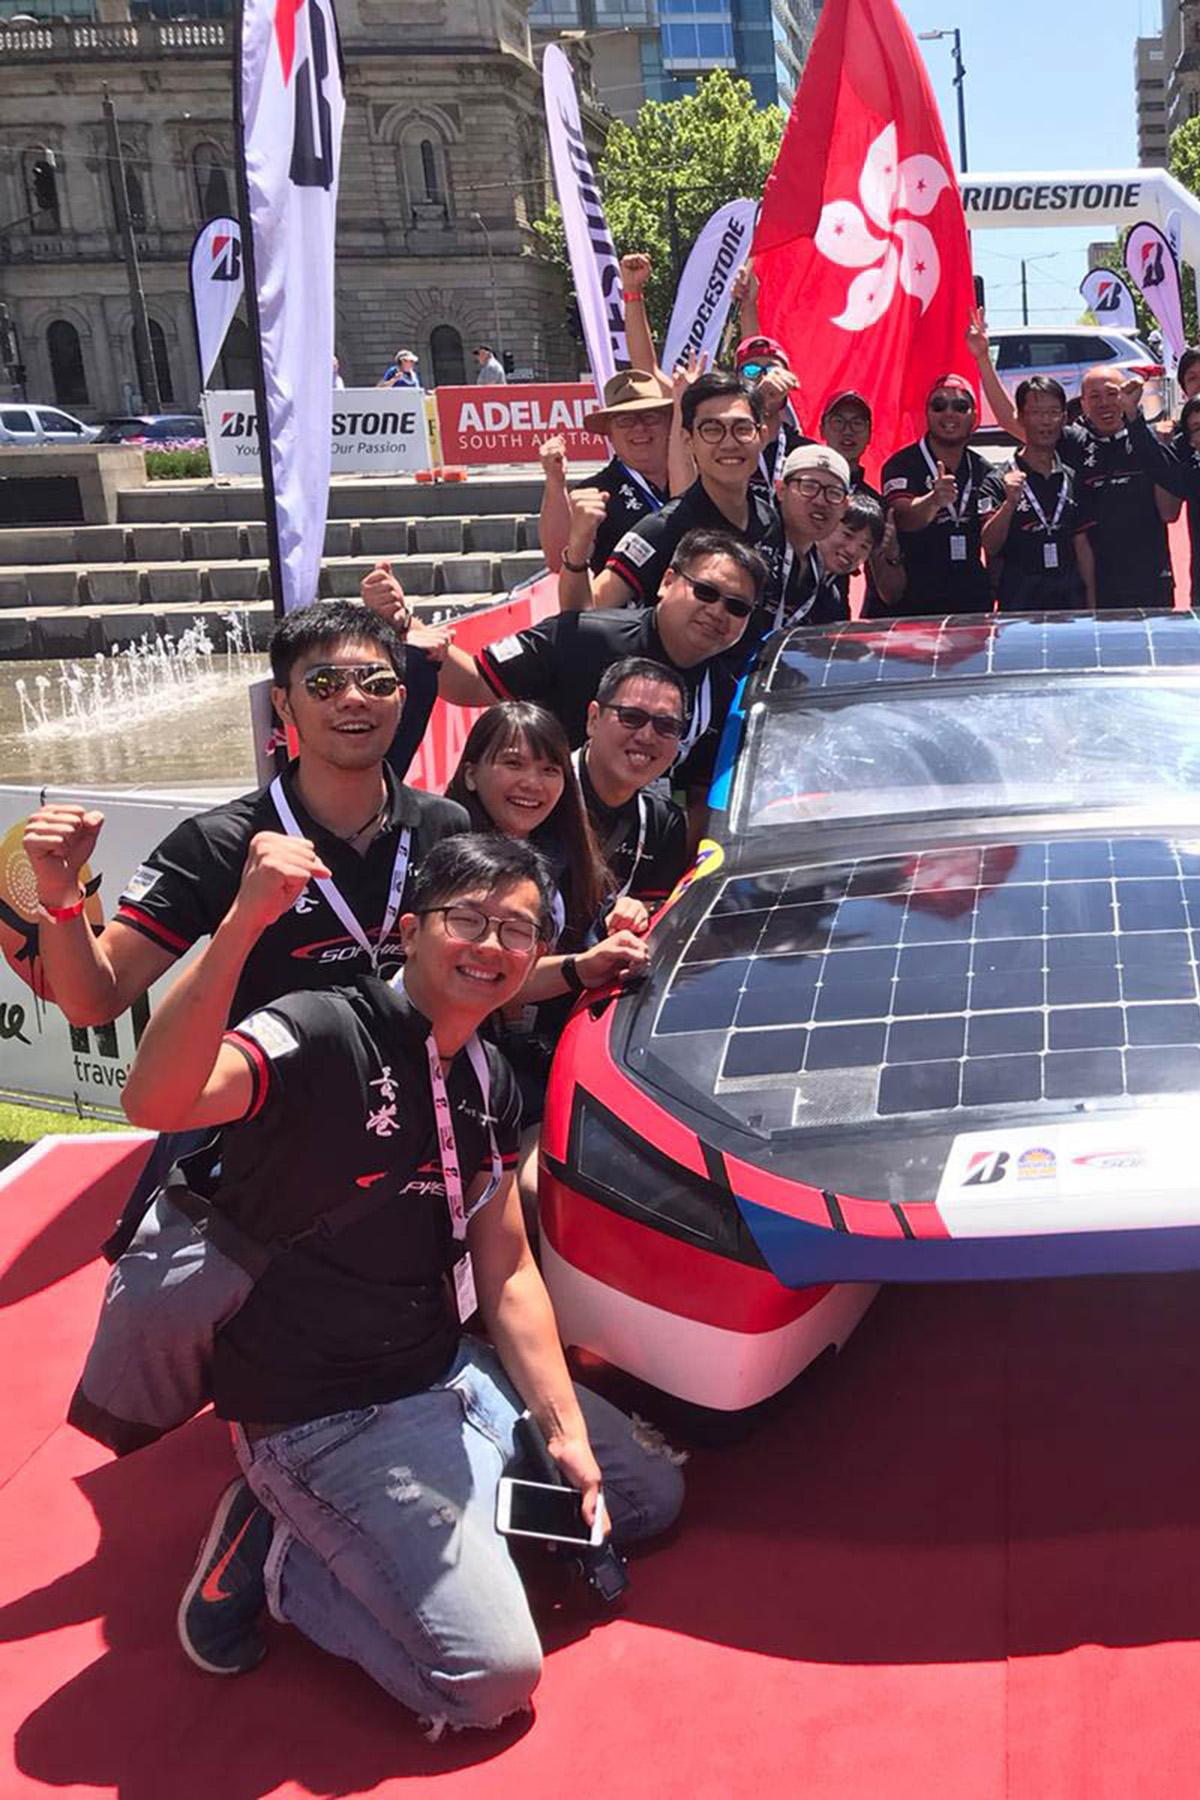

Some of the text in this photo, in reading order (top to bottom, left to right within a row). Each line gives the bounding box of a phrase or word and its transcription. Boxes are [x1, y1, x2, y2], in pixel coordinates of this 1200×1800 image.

[961, 183, 1141, 211] RIDGESTONE
[220, 411, 416, 438] BRSTONE
[357, 441, 406, 455] Passion
[459, 434, 523, 450] SOUTH
[73, 1054, 131, 1089] trave
